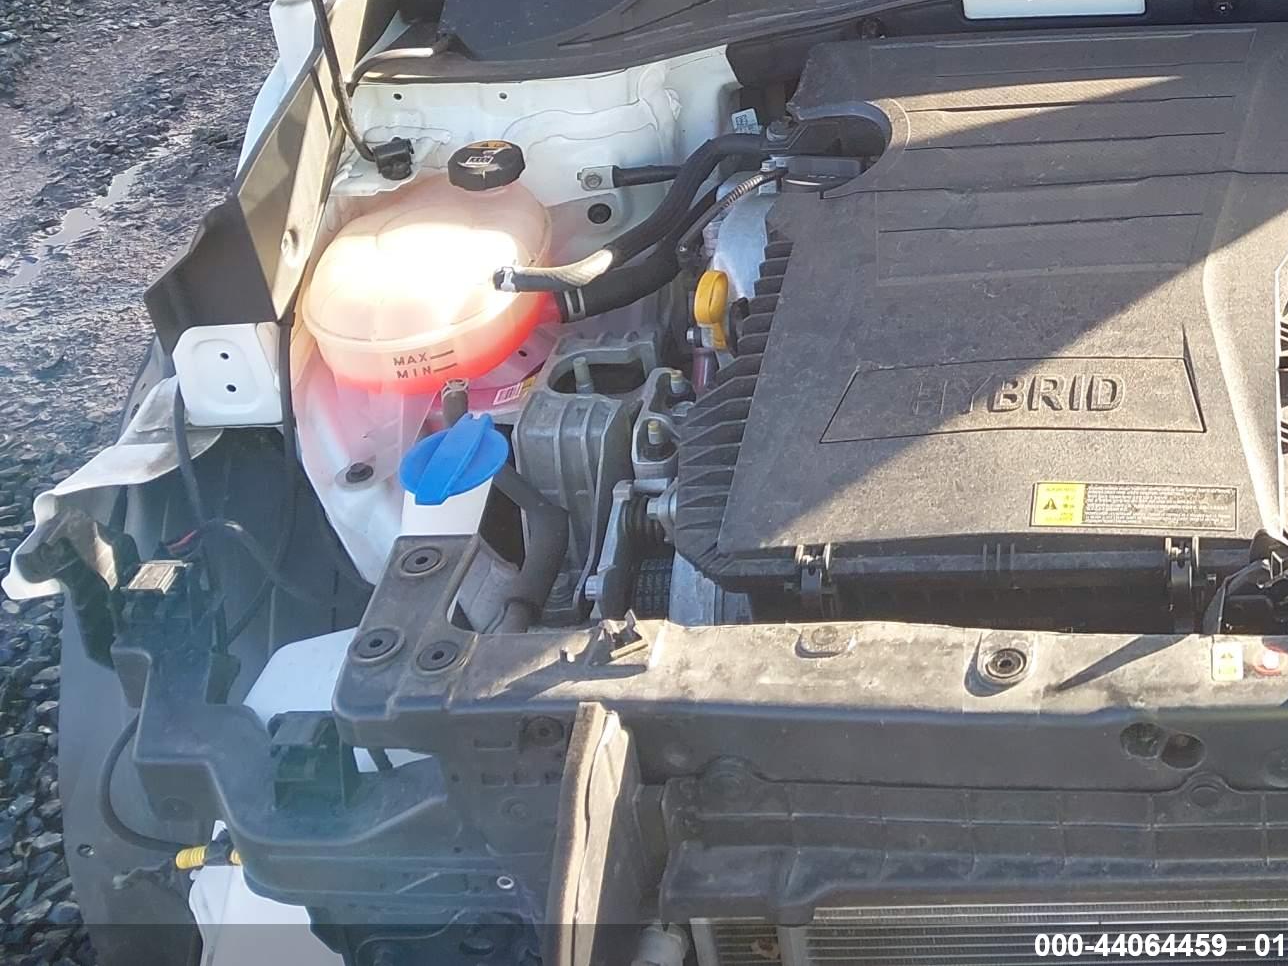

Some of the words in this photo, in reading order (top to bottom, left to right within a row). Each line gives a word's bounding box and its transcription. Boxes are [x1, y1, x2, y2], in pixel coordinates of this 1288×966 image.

[393, 352, 428, 366] MAX
[396, 365, 431, 379] MIN
[911, 373, 1126, 416] HYBRID
